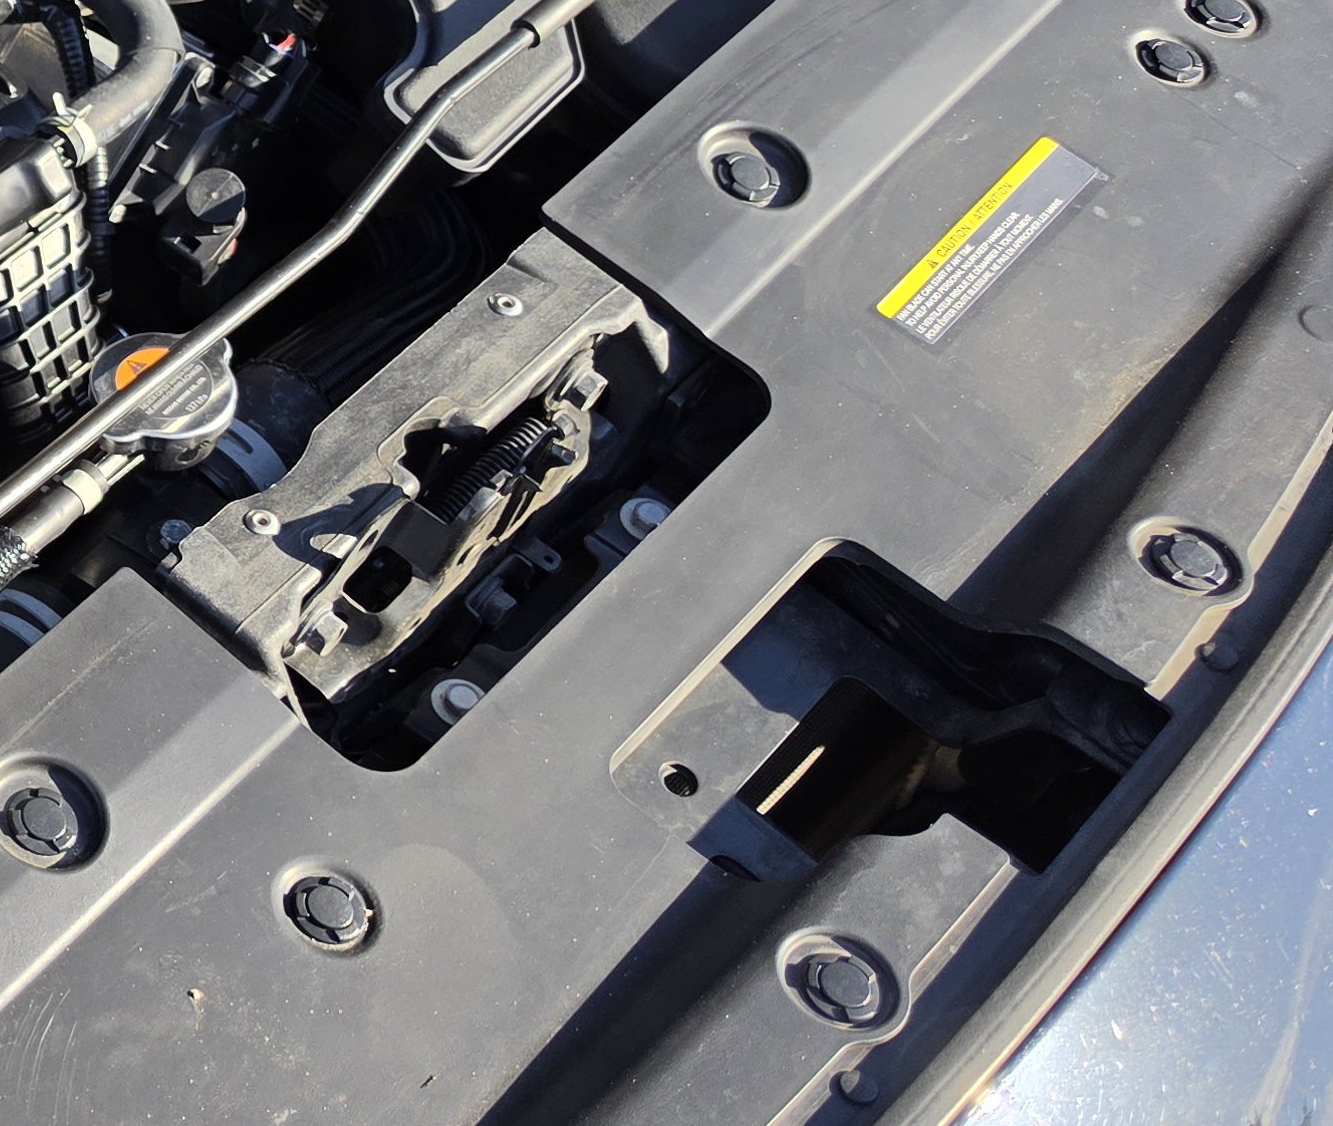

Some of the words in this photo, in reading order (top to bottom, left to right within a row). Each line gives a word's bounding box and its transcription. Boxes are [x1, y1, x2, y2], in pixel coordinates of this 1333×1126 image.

[935, 223, 971, 258] CAUTION
[971, 180, 1013, 220] ATTENTION
[998, 232, 1014, 247] TOUT
[943, 263, 955, 273] AT
[948, 254, 963, 267] ANY
[924, 323, 942, 340] POUR
[951, 292, 971, 310] TOUTE
[988, 261, 1001, 272] NE
[995, 252, 1009, 265] PAS
[1035, 210, 1049, 222] LES
[929, 269, 949, 286] START
[964, 272, 976, 282] DE
[905, 317, 917, 327] TO
[911, 304, 929, 320] HELP
[923, 291, 942, 308] AVOID
[936, 266, 965, 294] PERSONAL
[919, 283, 935, 297] CAN
[948, 278, 970, 299] RISQUE
[905, 293, 926, 312] BLADE
[896, 308, 911, 321] FAN
[920, 295, 954, 328] VENTILATEUR
[915, 324, 927, 334] LE
